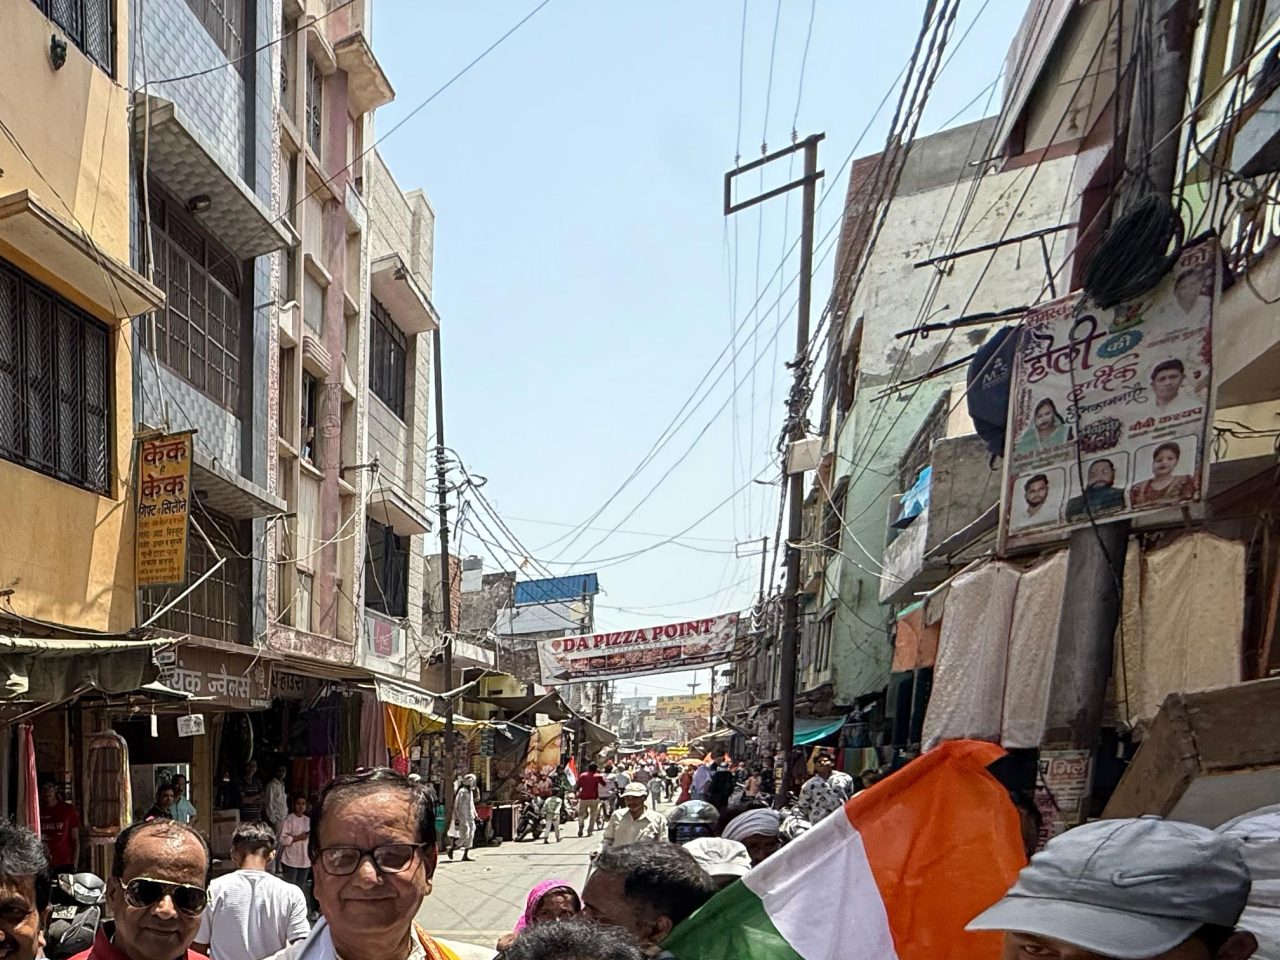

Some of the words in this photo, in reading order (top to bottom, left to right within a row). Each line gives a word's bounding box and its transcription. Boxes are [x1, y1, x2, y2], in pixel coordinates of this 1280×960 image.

[1024, 315, 1107, 384] होली
[1108, 335, 1131, 352] की
[143, 441, 186, 465] केक
[142, 473, 184, 498] केक
[563, 637, 589, 652] DA
[593, 628, 648, 649] PIZZA
[651, 618, 717, 640] POINT
